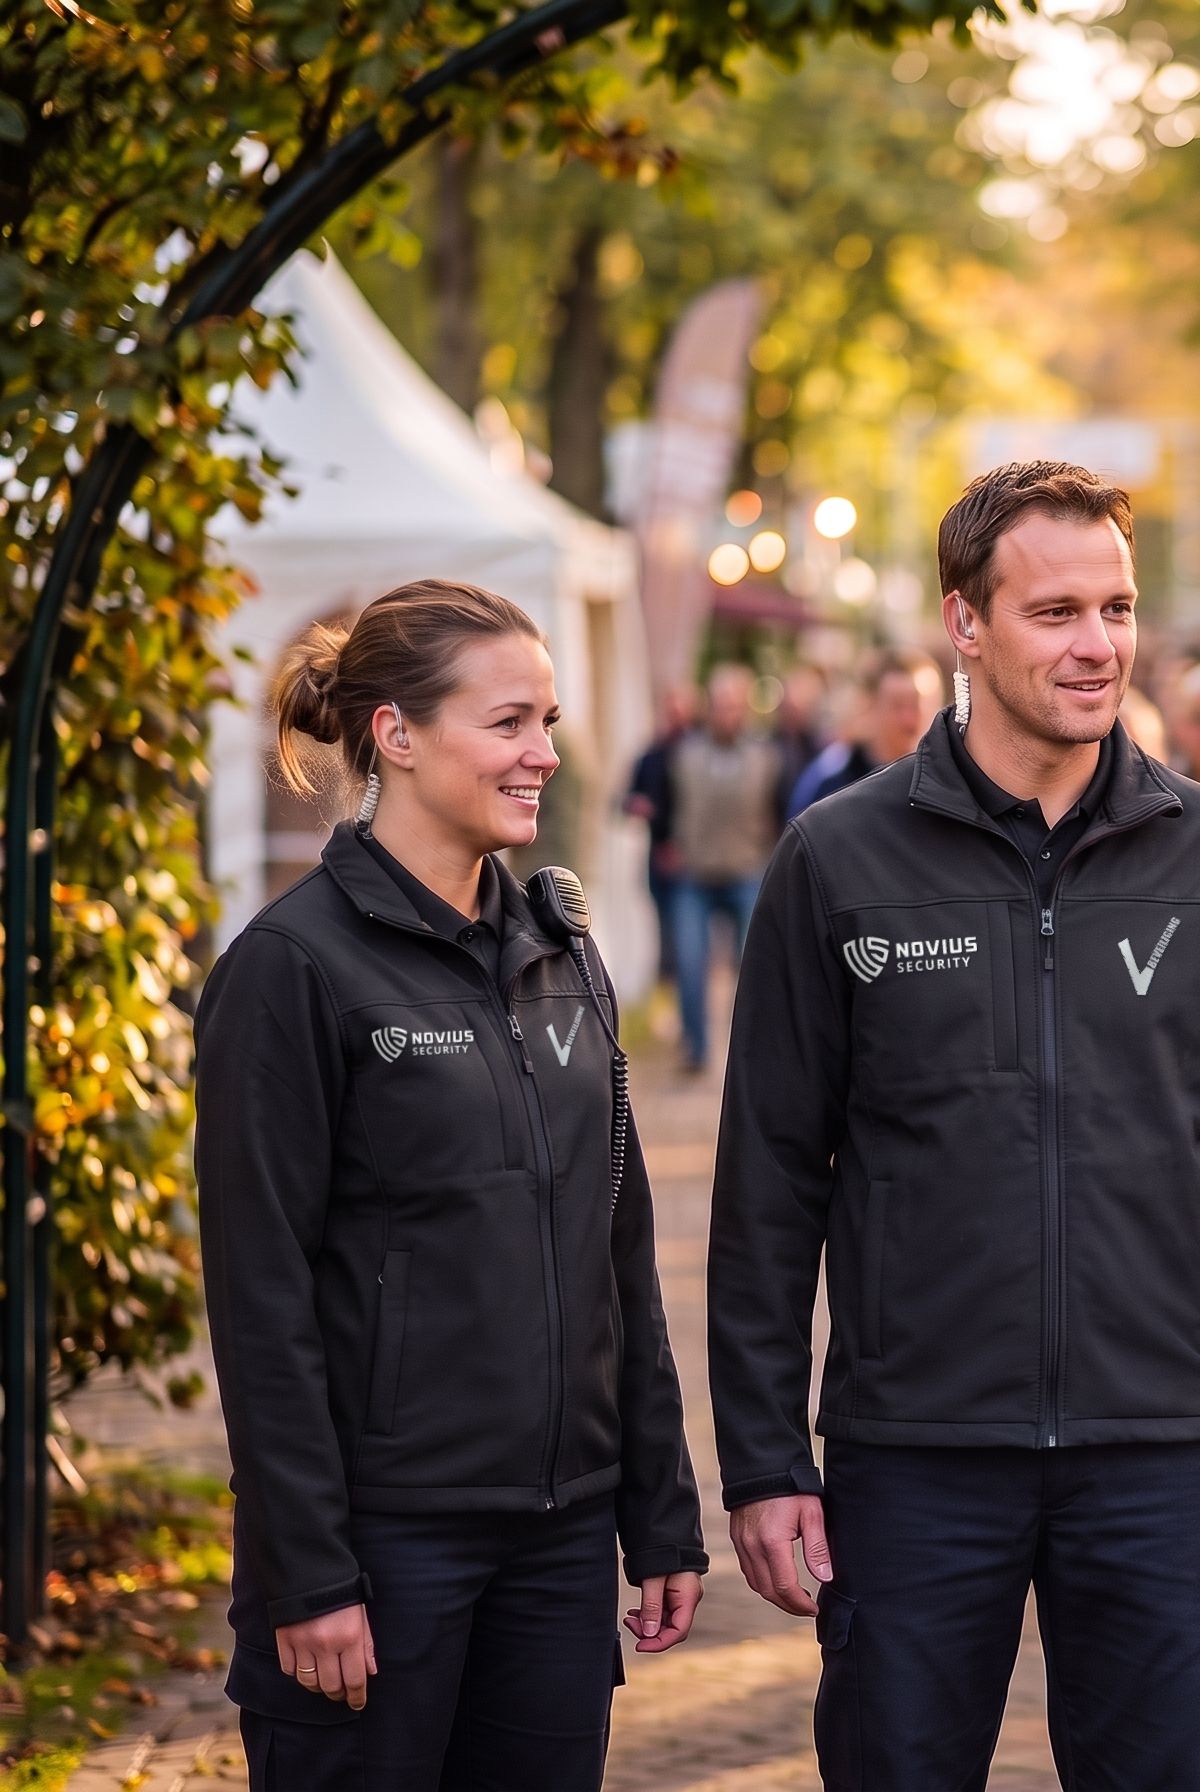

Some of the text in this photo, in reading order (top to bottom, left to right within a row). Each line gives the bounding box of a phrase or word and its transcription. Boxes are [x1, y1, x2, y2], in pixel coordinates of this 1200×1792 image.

[896, 936, 978, 959] NOVIUS
[897, 956, 971, 974] SECURITY
[412, 1030, 474, 1044] NOVIUS
[412, 1045, 469, 1056] SECURITY
